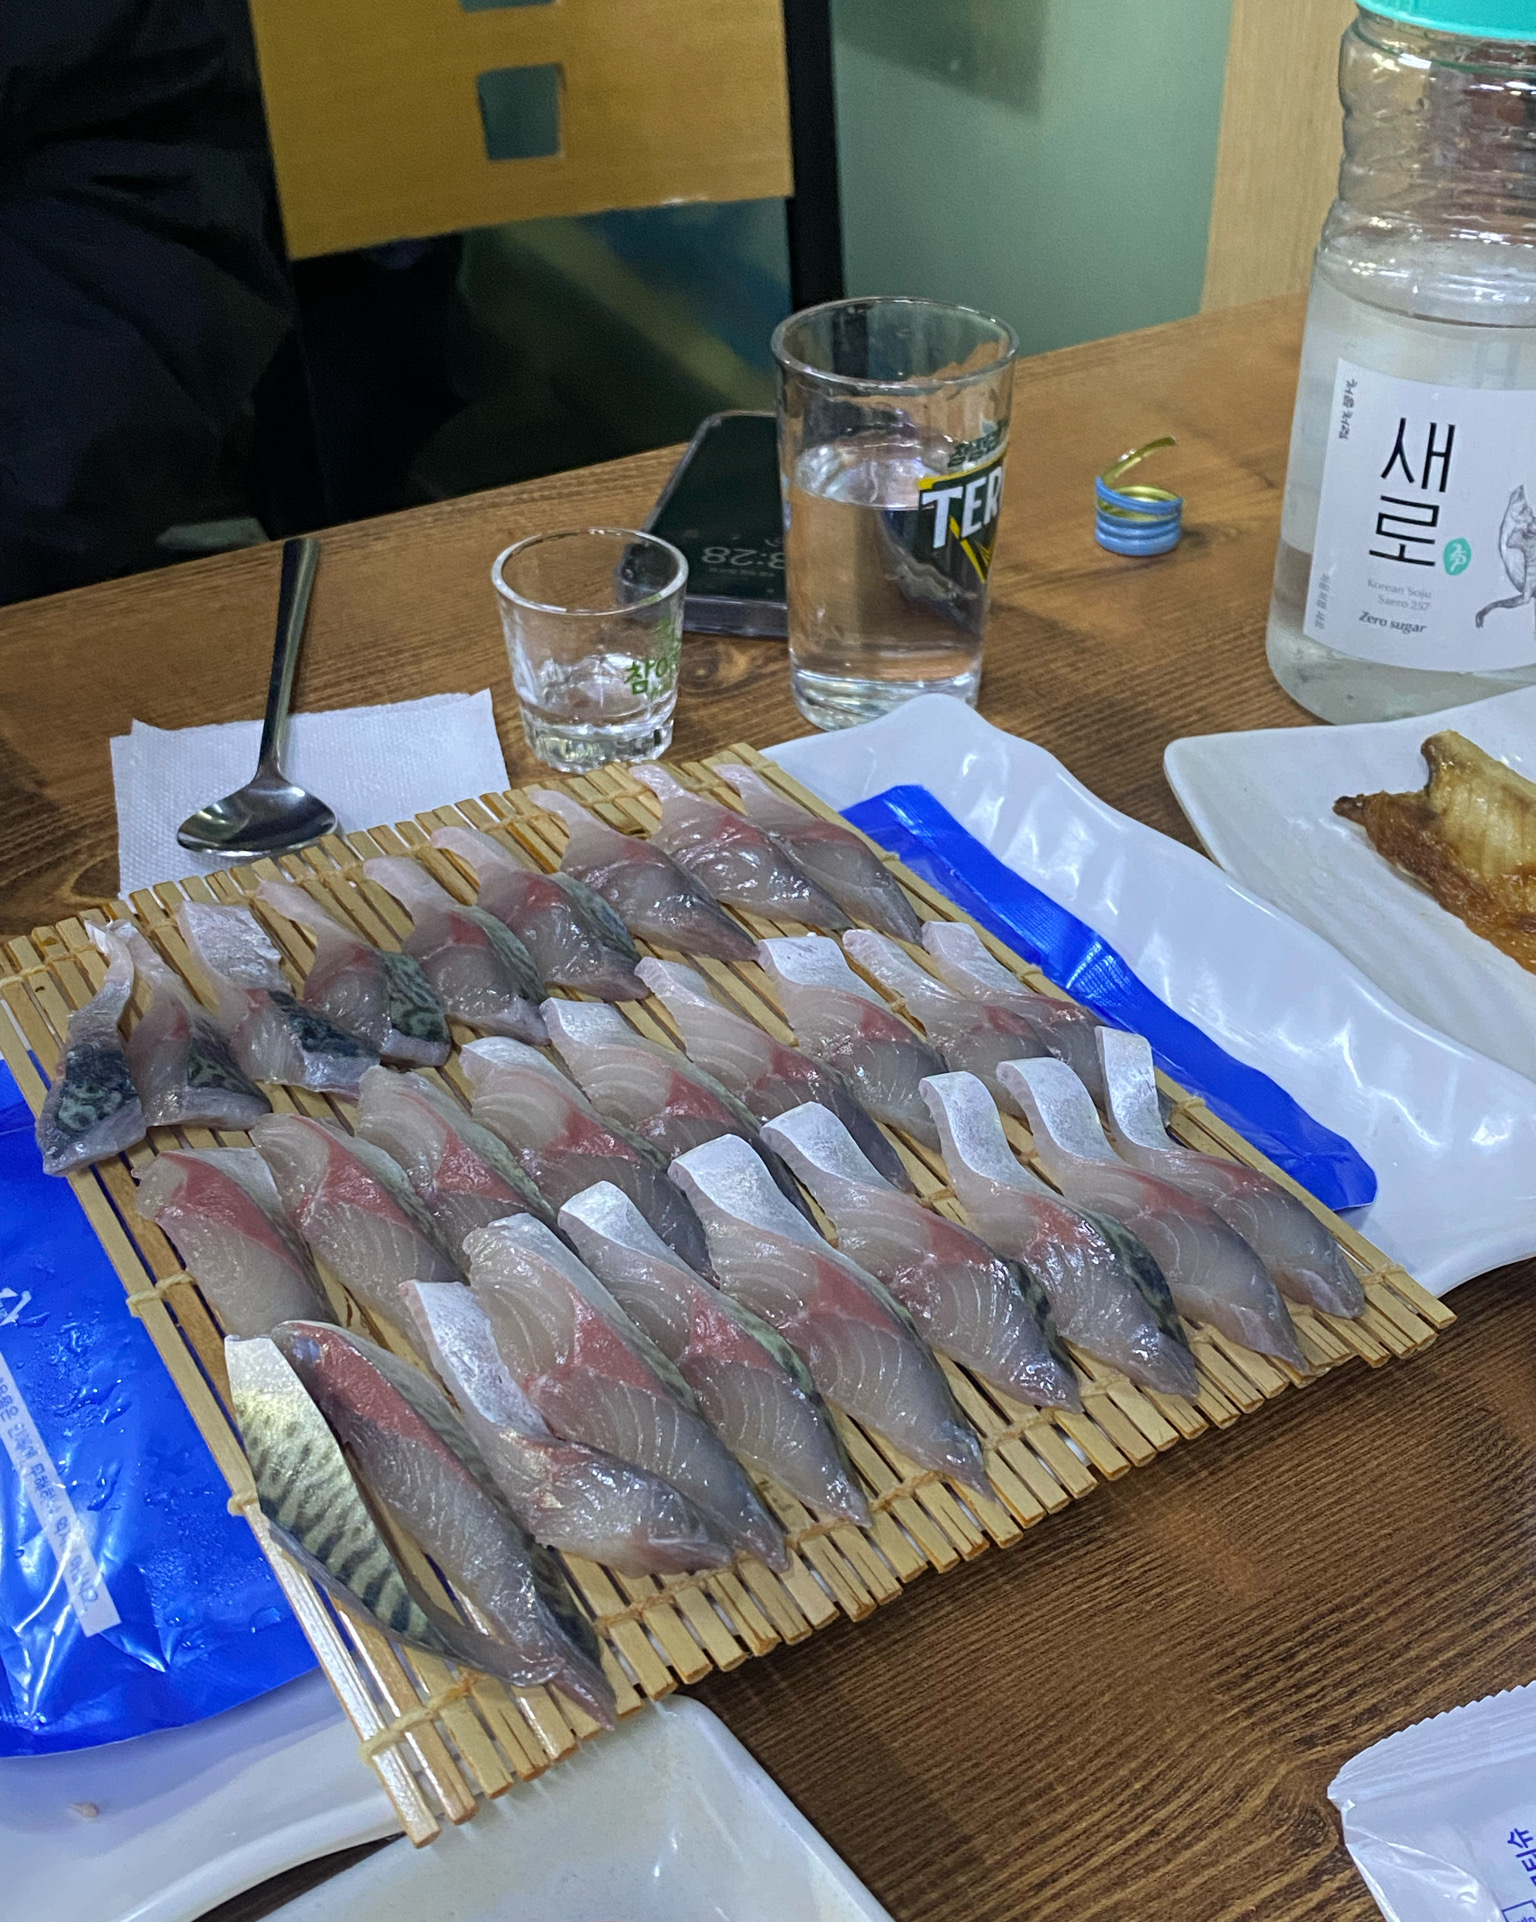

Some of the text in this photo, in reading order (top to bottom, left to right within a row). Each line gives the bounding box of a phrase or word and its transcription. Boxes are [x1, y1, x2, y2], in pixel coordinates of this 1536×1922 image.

[1369, 417, 1456, 567] 새로
[1367, 578, 1432, 599] Korean Soju
[1378, 594, 1409, 609] Saero
[1359, 610, 1427, 634] Zero sugar
[1507, 1828, 1536, 1887] 티슈
